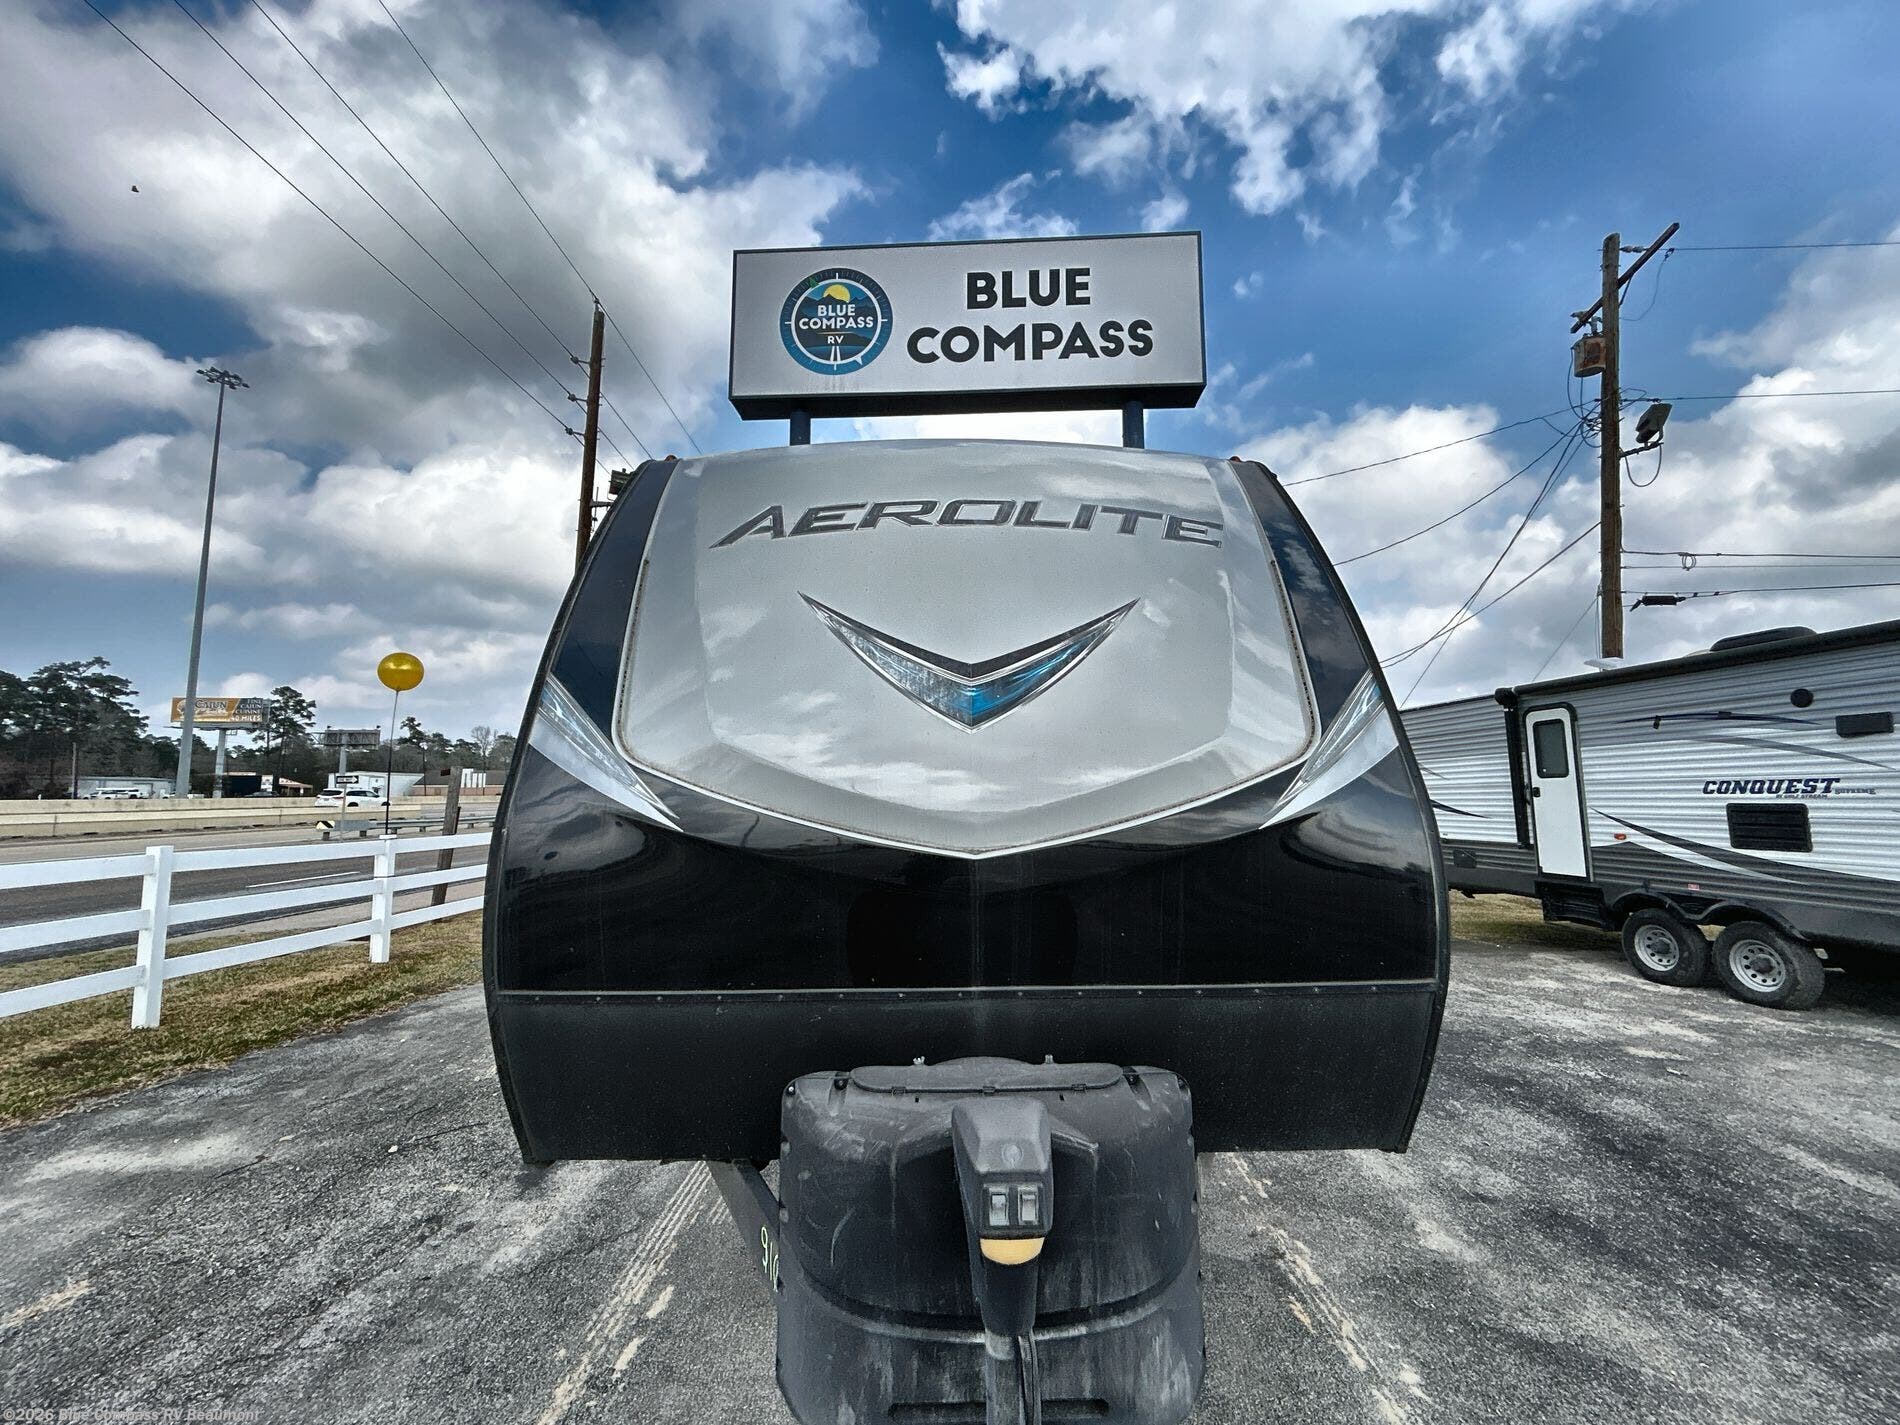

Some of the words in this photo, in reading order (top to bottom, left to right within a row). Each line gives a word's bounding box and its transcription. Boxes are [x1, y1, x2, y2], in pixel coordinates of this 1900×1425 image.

[966, 267, 1091, 310] BLUE
[817, 304, 856, 317] BLUE
[798, 316, 874, 330] COMPASS
[827, 335, 844, 344] RV
[906, 318, 1154, 364] COMPASS
[708, 498, 1224, 549] AEROLITE
[241, 714, 262, 722] MILES
[1702, 778, 1841, 795] CONQUEST
